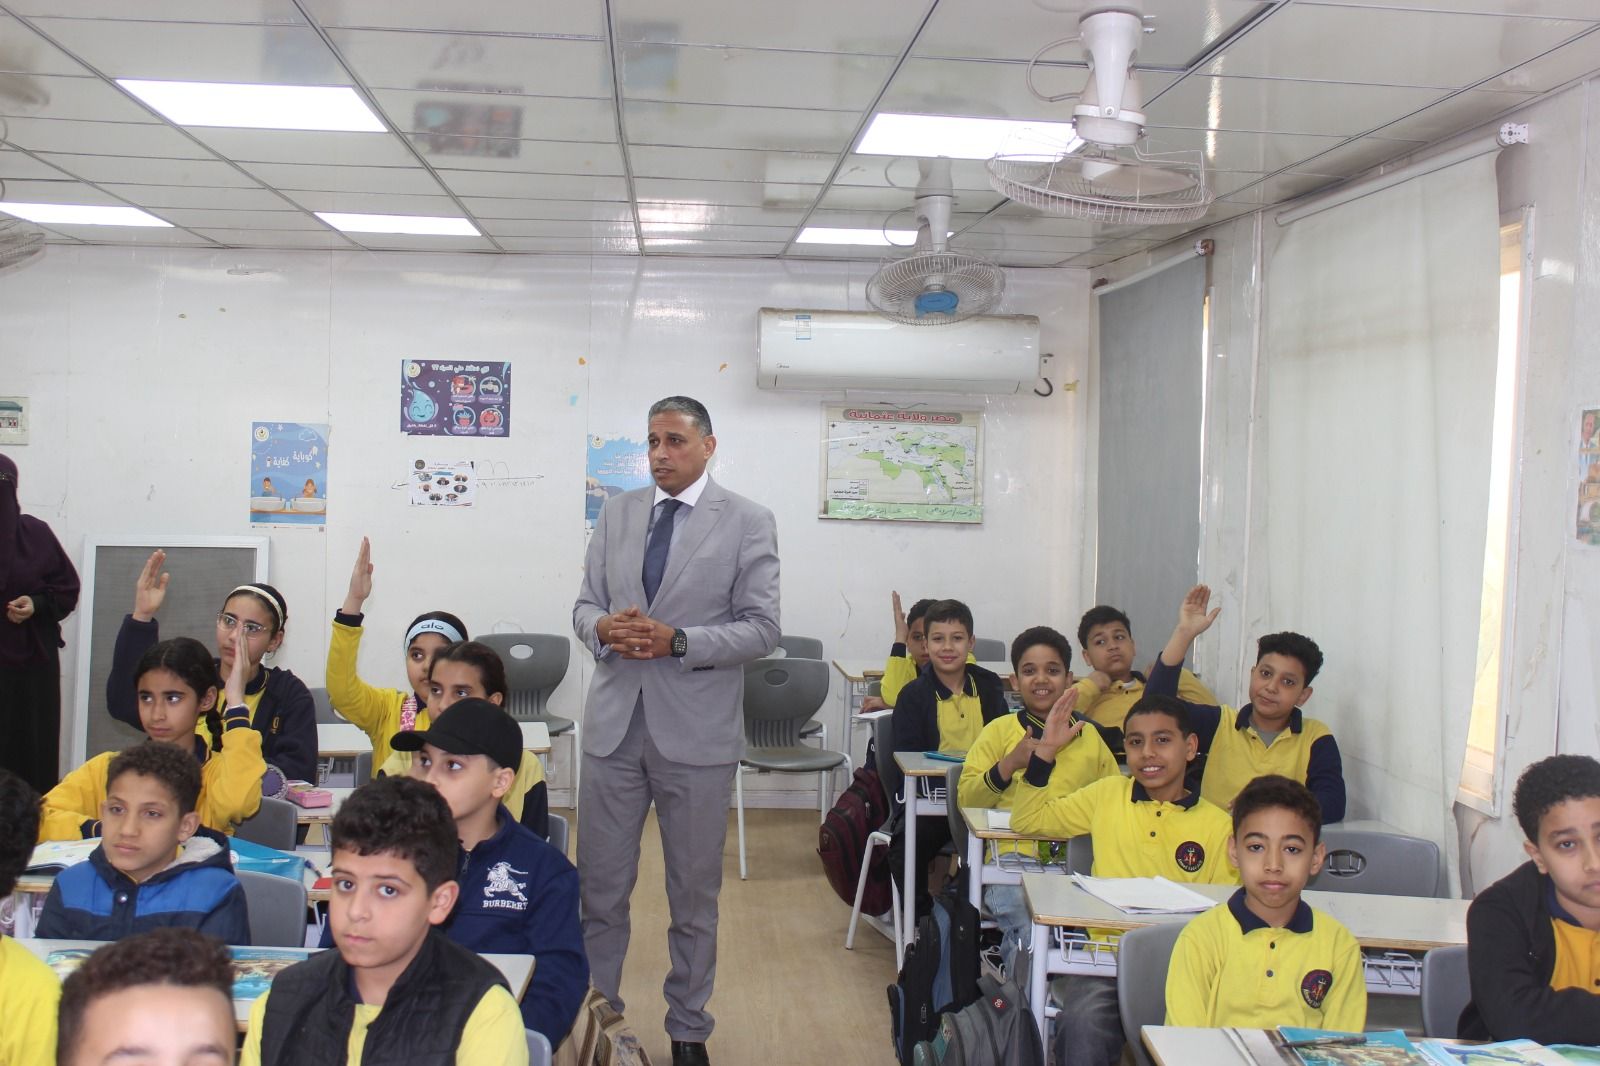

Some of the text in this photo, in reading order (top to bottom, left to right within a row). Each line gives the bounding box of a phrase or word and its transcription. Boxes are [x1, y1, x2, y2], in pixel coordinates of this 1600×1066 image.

[849, 410, 894, 420] عثمانية
[931, 415, 956, 423] مصر
[273, 450, 313, 469] كوباية كفاية
[482, 899, 529, 910] BURBERRY
